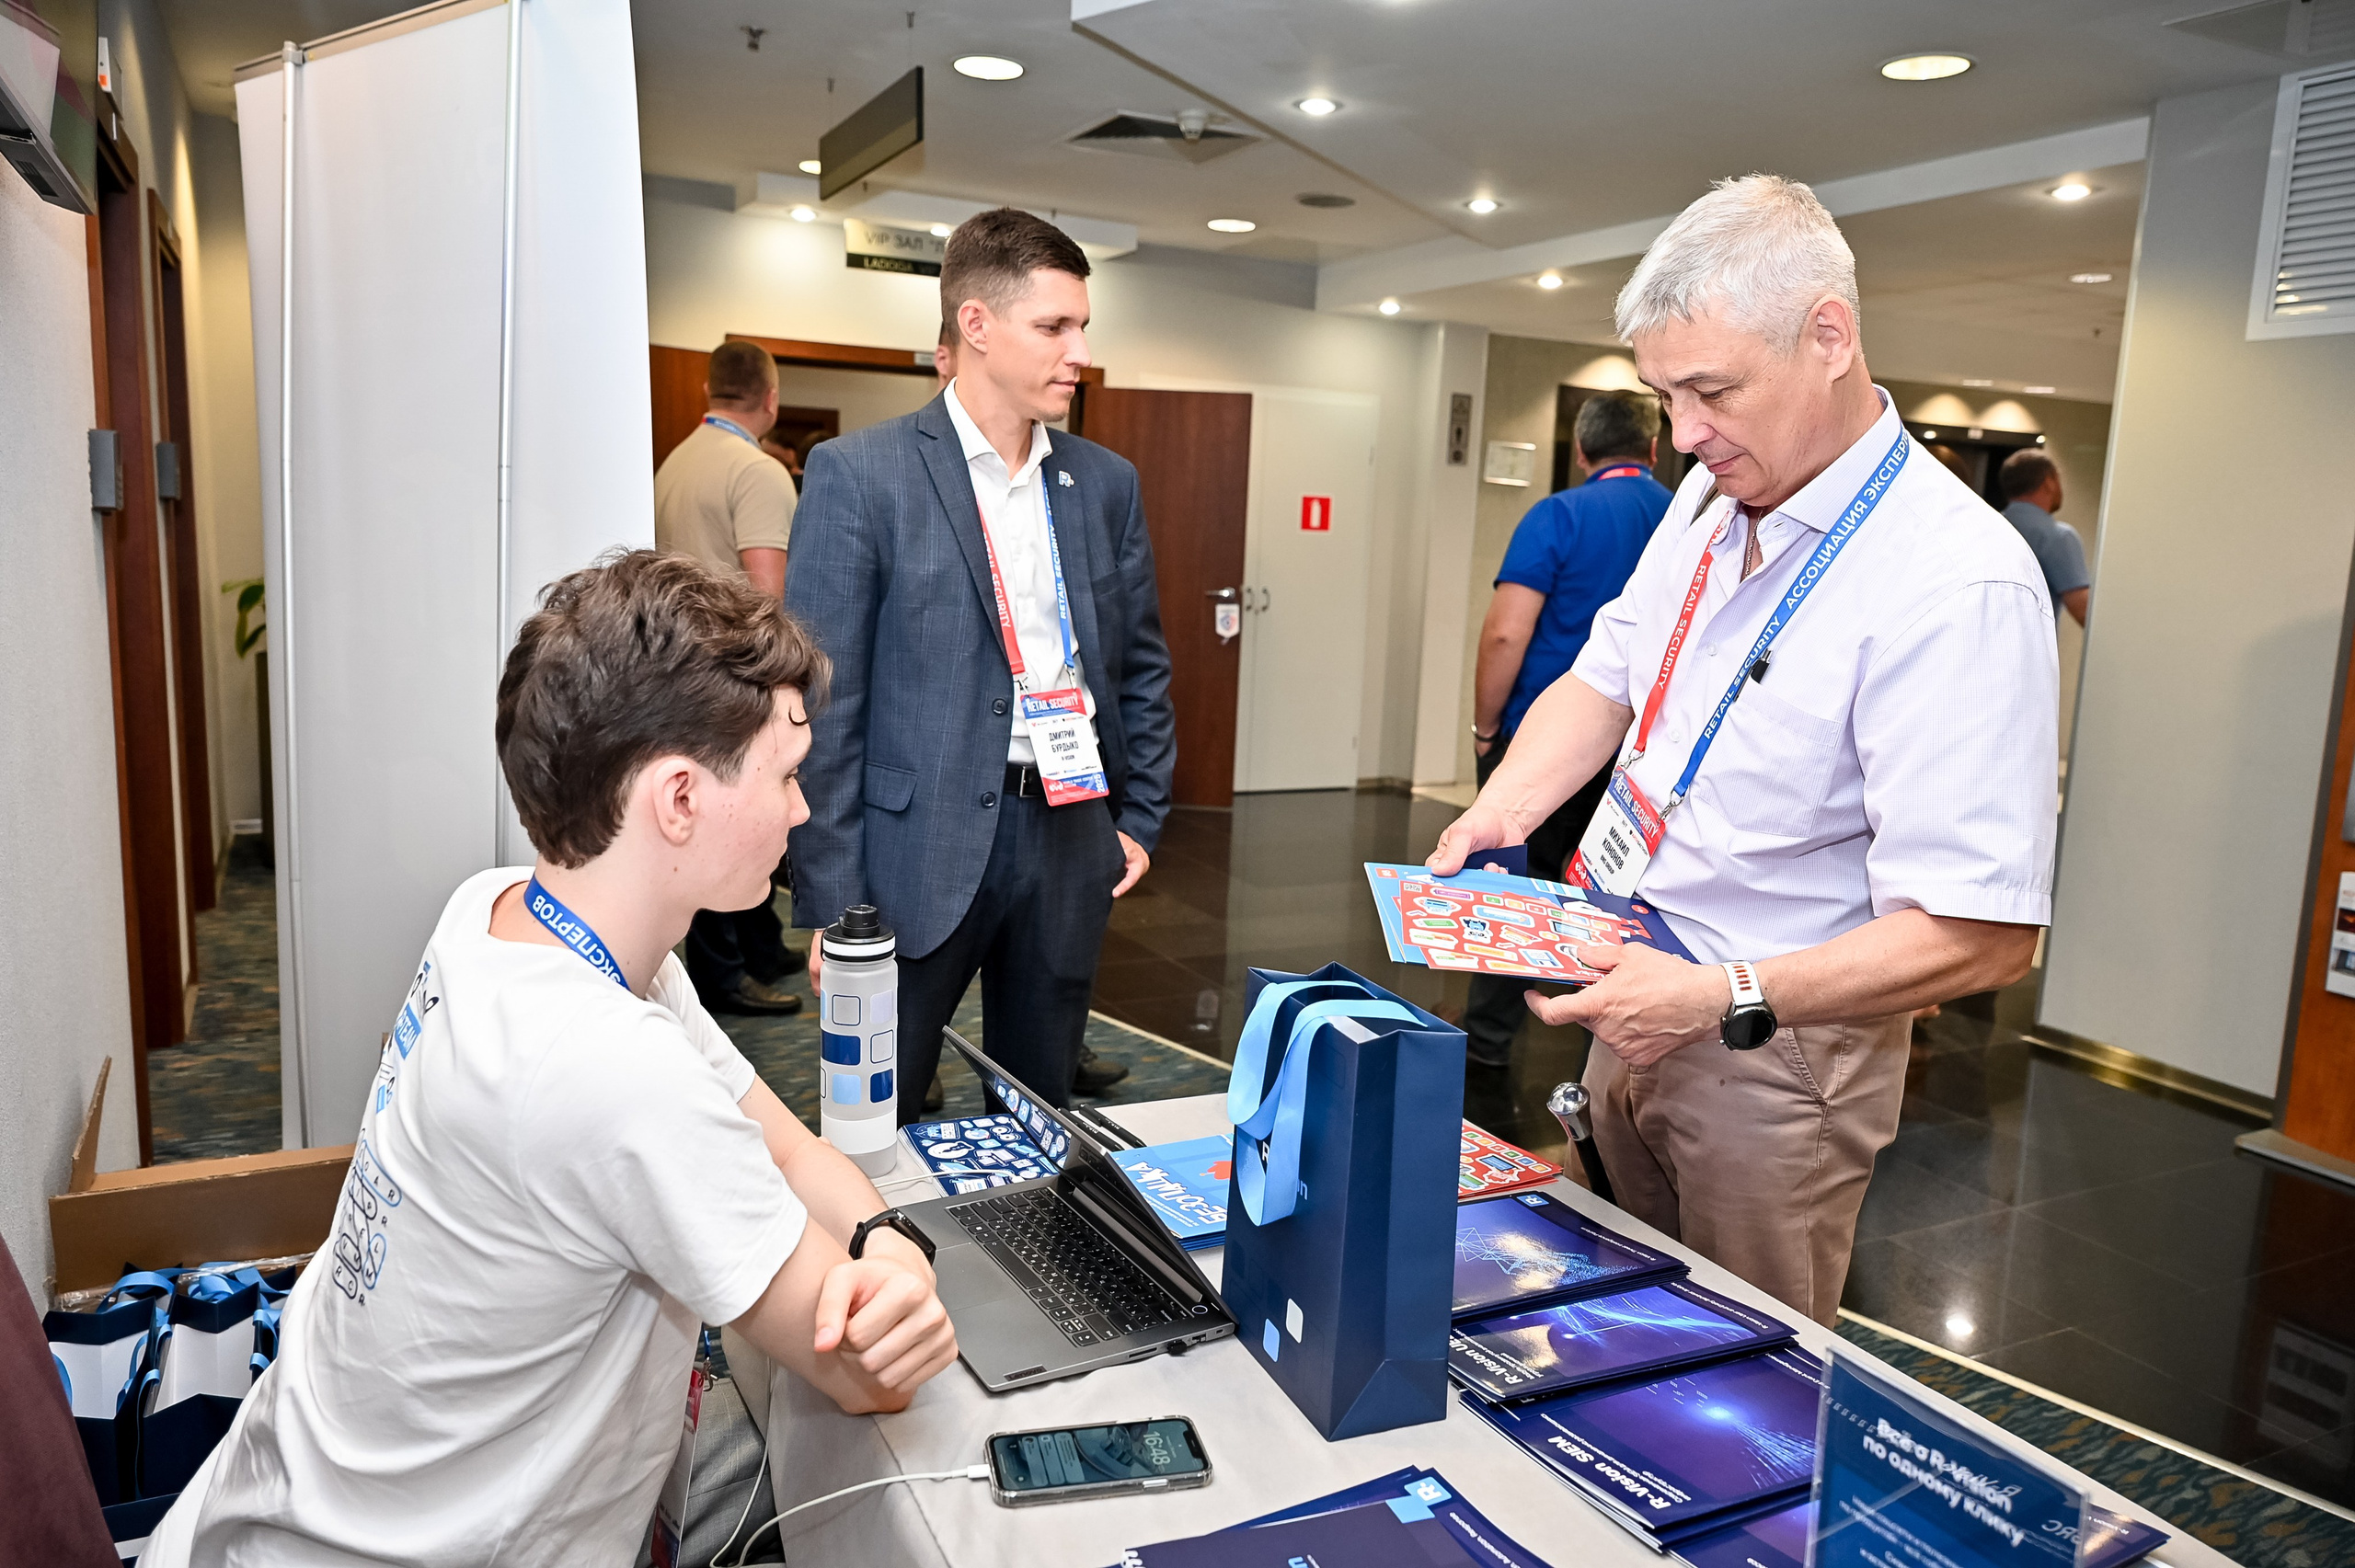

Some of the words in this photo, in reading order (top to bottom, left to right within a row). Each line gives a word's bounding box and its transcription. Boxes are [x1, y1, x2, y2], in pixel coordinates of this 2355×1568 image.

[1056, 580, 1067, 620] RETAIL
[1683, 563, 1707, 615] RETAIL
[1704, 689, 1735, 740] RETAIL
[1733, 614, 1781, 688] SECURITY
[1785, 498, 1868, 611] АССОЦИАЦИЯ
[1658, 618, 1688, 690] SECURITY
[1026, 698, 1050, 713] RETAIL
[1051, 695, 1079, 710] SECURITY
[1049, 727, 1076, 742] ДМИТРИЙ
[1051, 740, 1080, 753] БУРДЫКО
[1614, 779, 1634, 807] RETAIL
[1631, 800, 1660, 839] SECURITY
[1602, 837, 1625, 870] КОНОНОВ
[1608, 826, 1630, 857] МИХАИЛ
[532, 894, 622, 983] ЭКСПЕРТОВ
[1465, 1346, 1523, 1385] R-Vision
[1143, 1430, 1171, 1467] 16:48
[1547, 1435, 1594, 1463] SIEM
[1594, 1461, 1671, 1509] R-Vision
[1863, 1435, 1887, 1460] по
[1889, 1450, 1962, 1509] одному
[1963, 1496, 2025, 1548] клику
